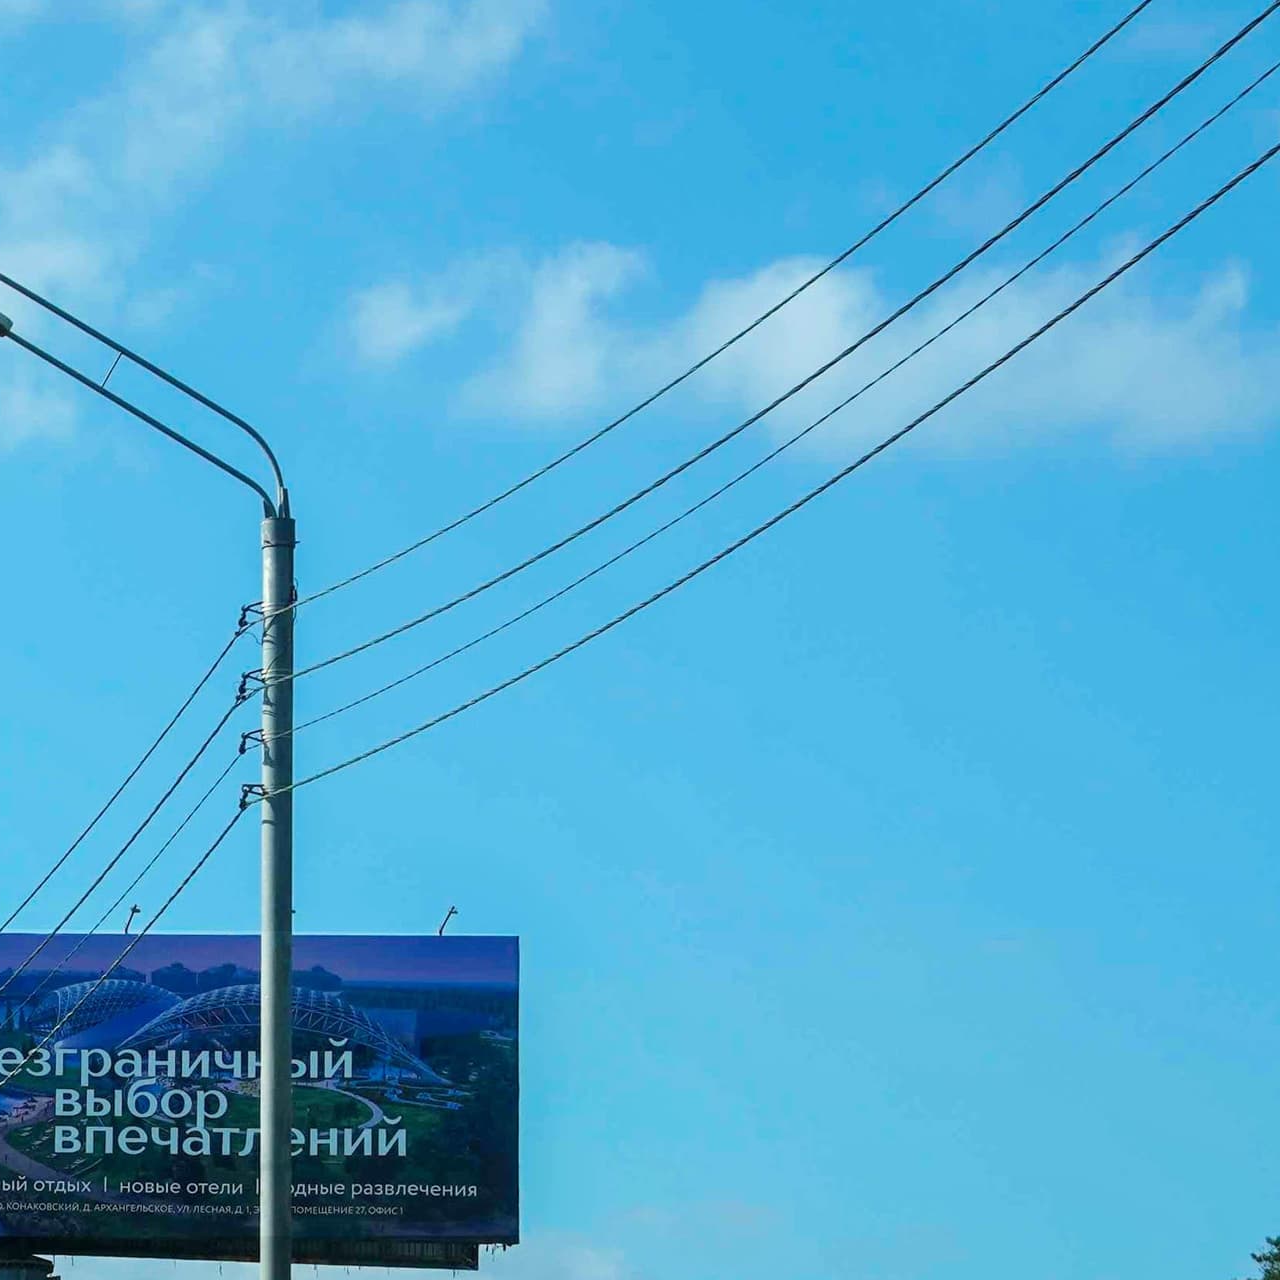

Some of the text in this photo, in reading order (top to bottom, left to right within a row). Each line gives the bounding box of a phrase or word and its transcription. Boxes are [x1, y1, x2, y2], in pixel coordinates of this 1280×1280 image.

[54, 1078, 228, 1128] выбор
[33, 1179, 91, 1195] отдых
[120, 1180, 243, 1195] новые отели
[351, 1182, 478, 1199] развлечения
[368, 1205, 398, 1216] ОФИС
